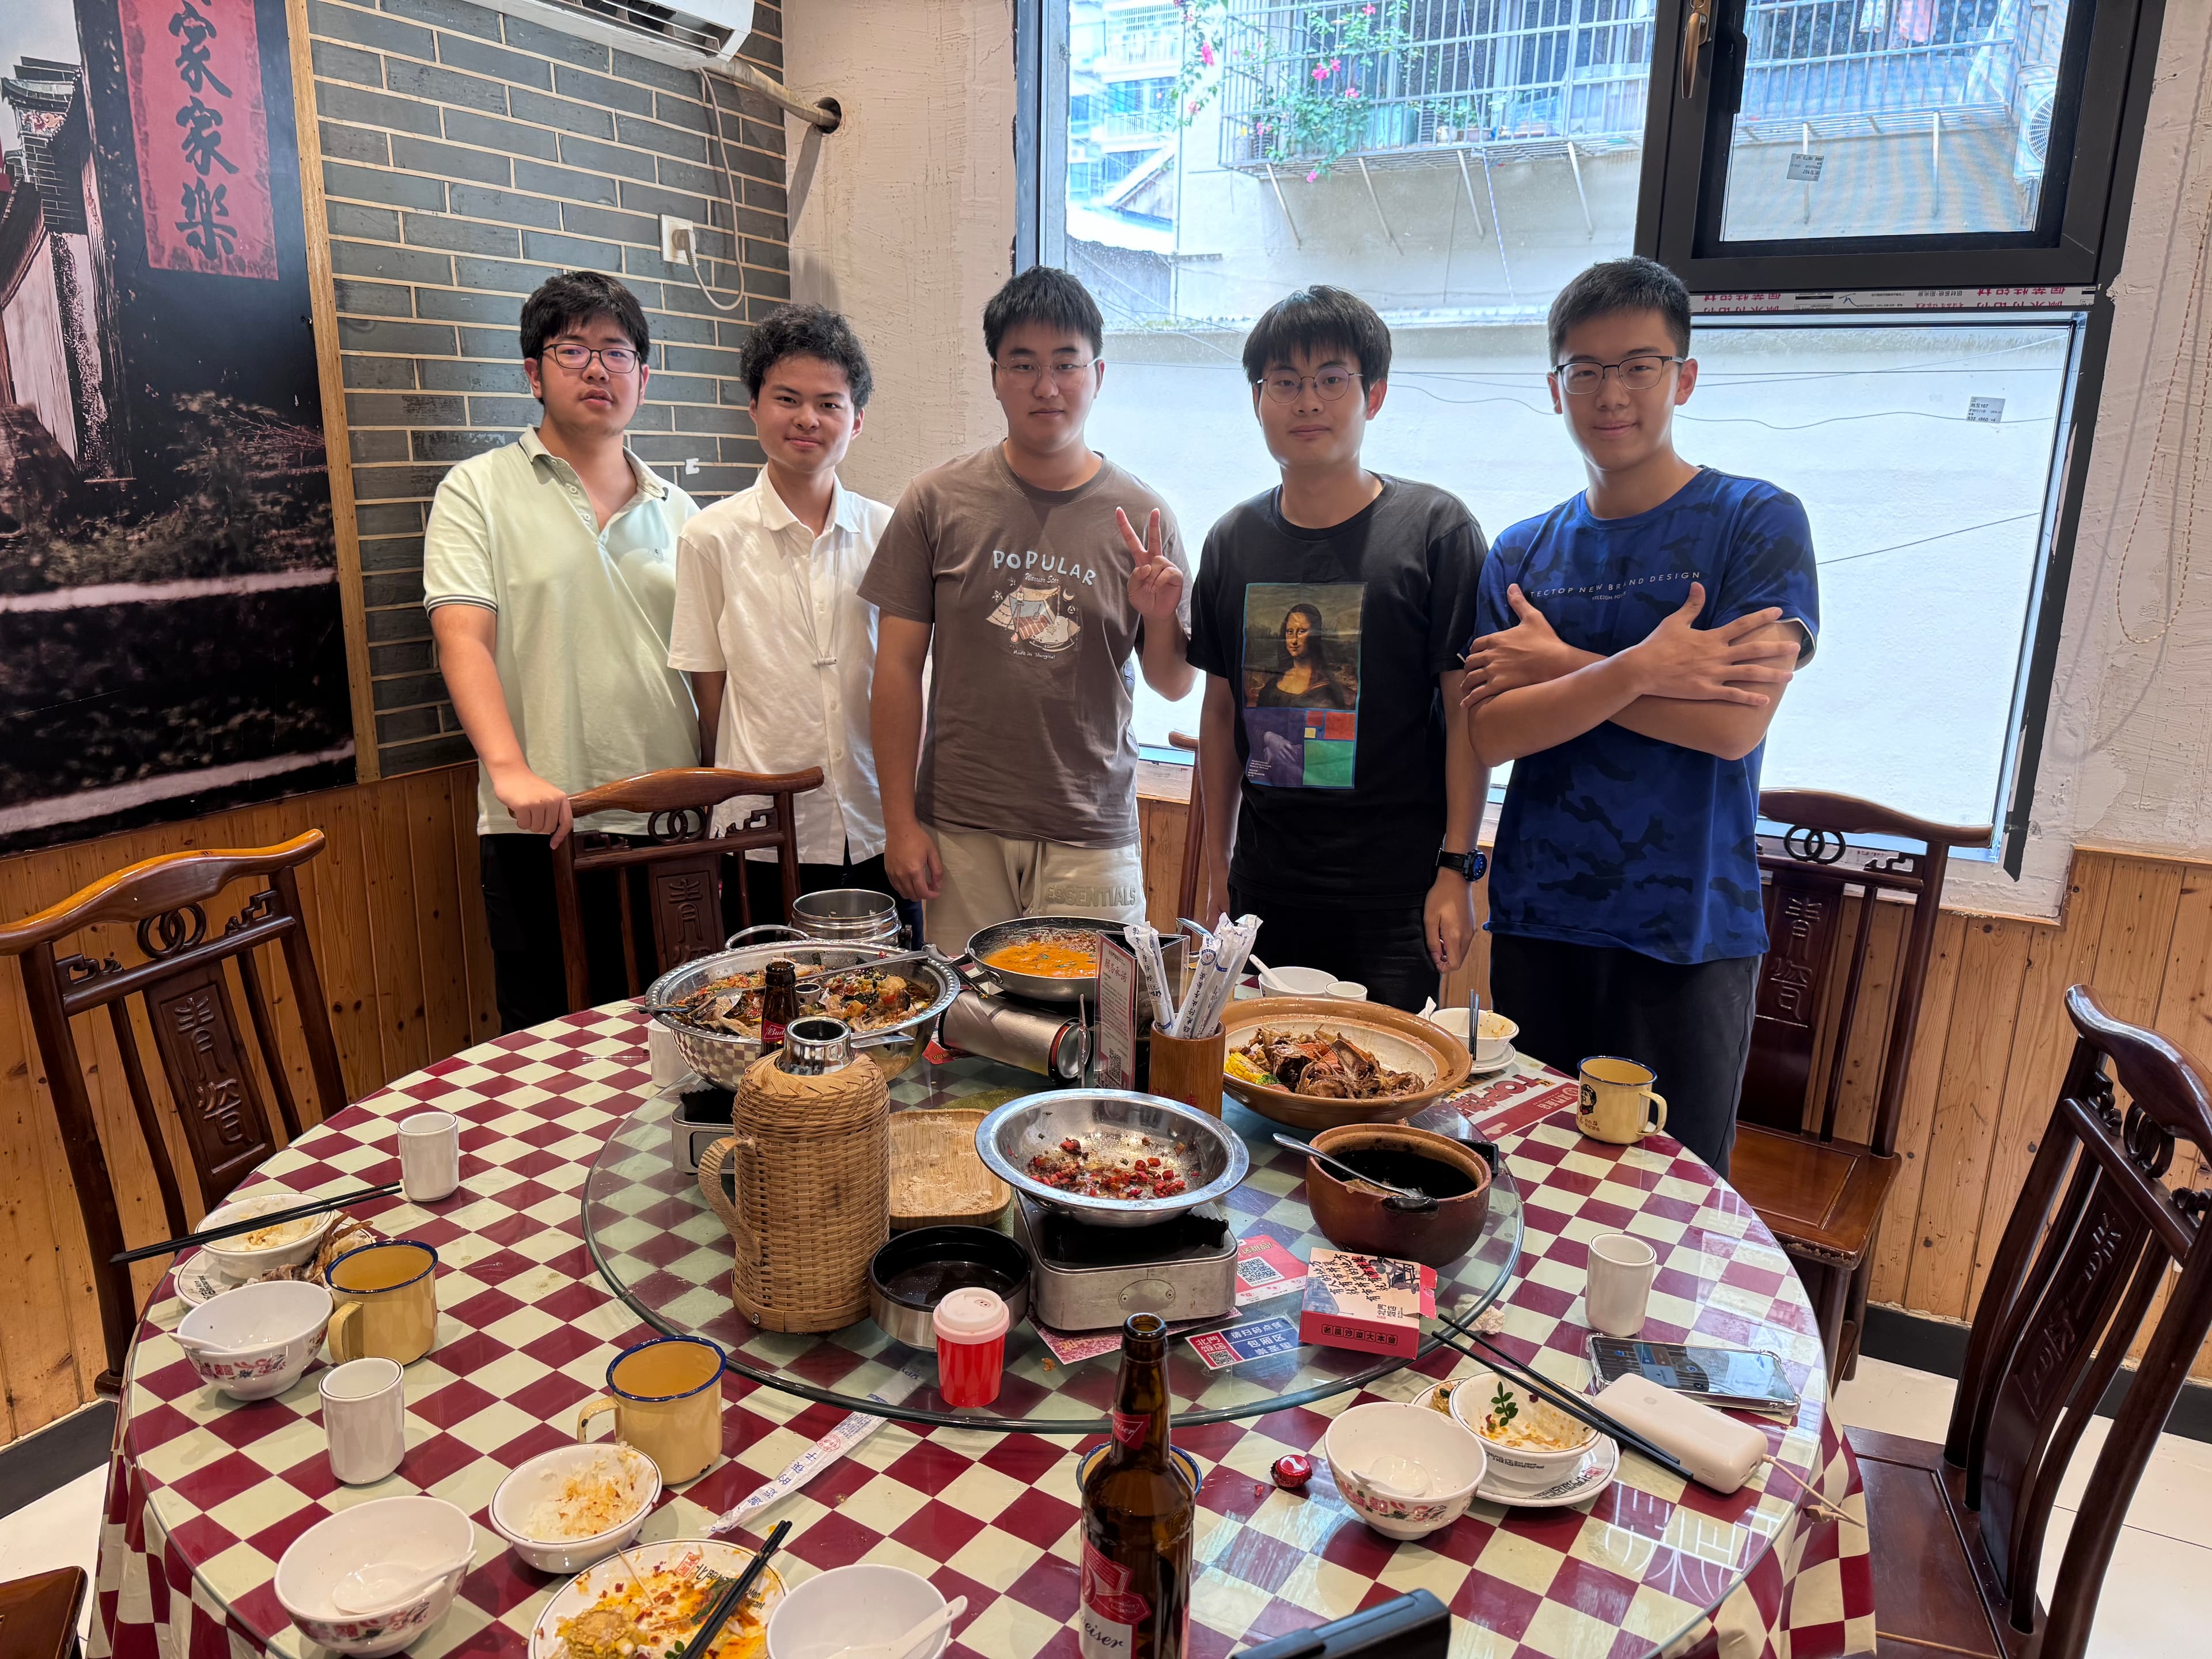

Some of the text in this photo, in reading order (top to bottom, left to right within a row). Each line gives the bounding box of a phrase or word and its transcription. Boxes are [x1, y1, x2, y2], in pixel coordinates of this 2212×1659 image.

[993, 550, 1096, 586] POPULAR
[1531, 586, 1574, 597] TECTOP
[1579, 584, 1603, 593] NEW
[1650, 572, 1699, 583] DESIGN
[1046, 885, 1136, 907] ESSENTIALS
[1195, 1335, 1220, 1346] 北門
[1230, 1322, 1283, 1339] 请扫码点餐
[1247, 1334, 1286, 1348] 包厢区
[747, 1452, 817, 1506] 邂逅的筷子
